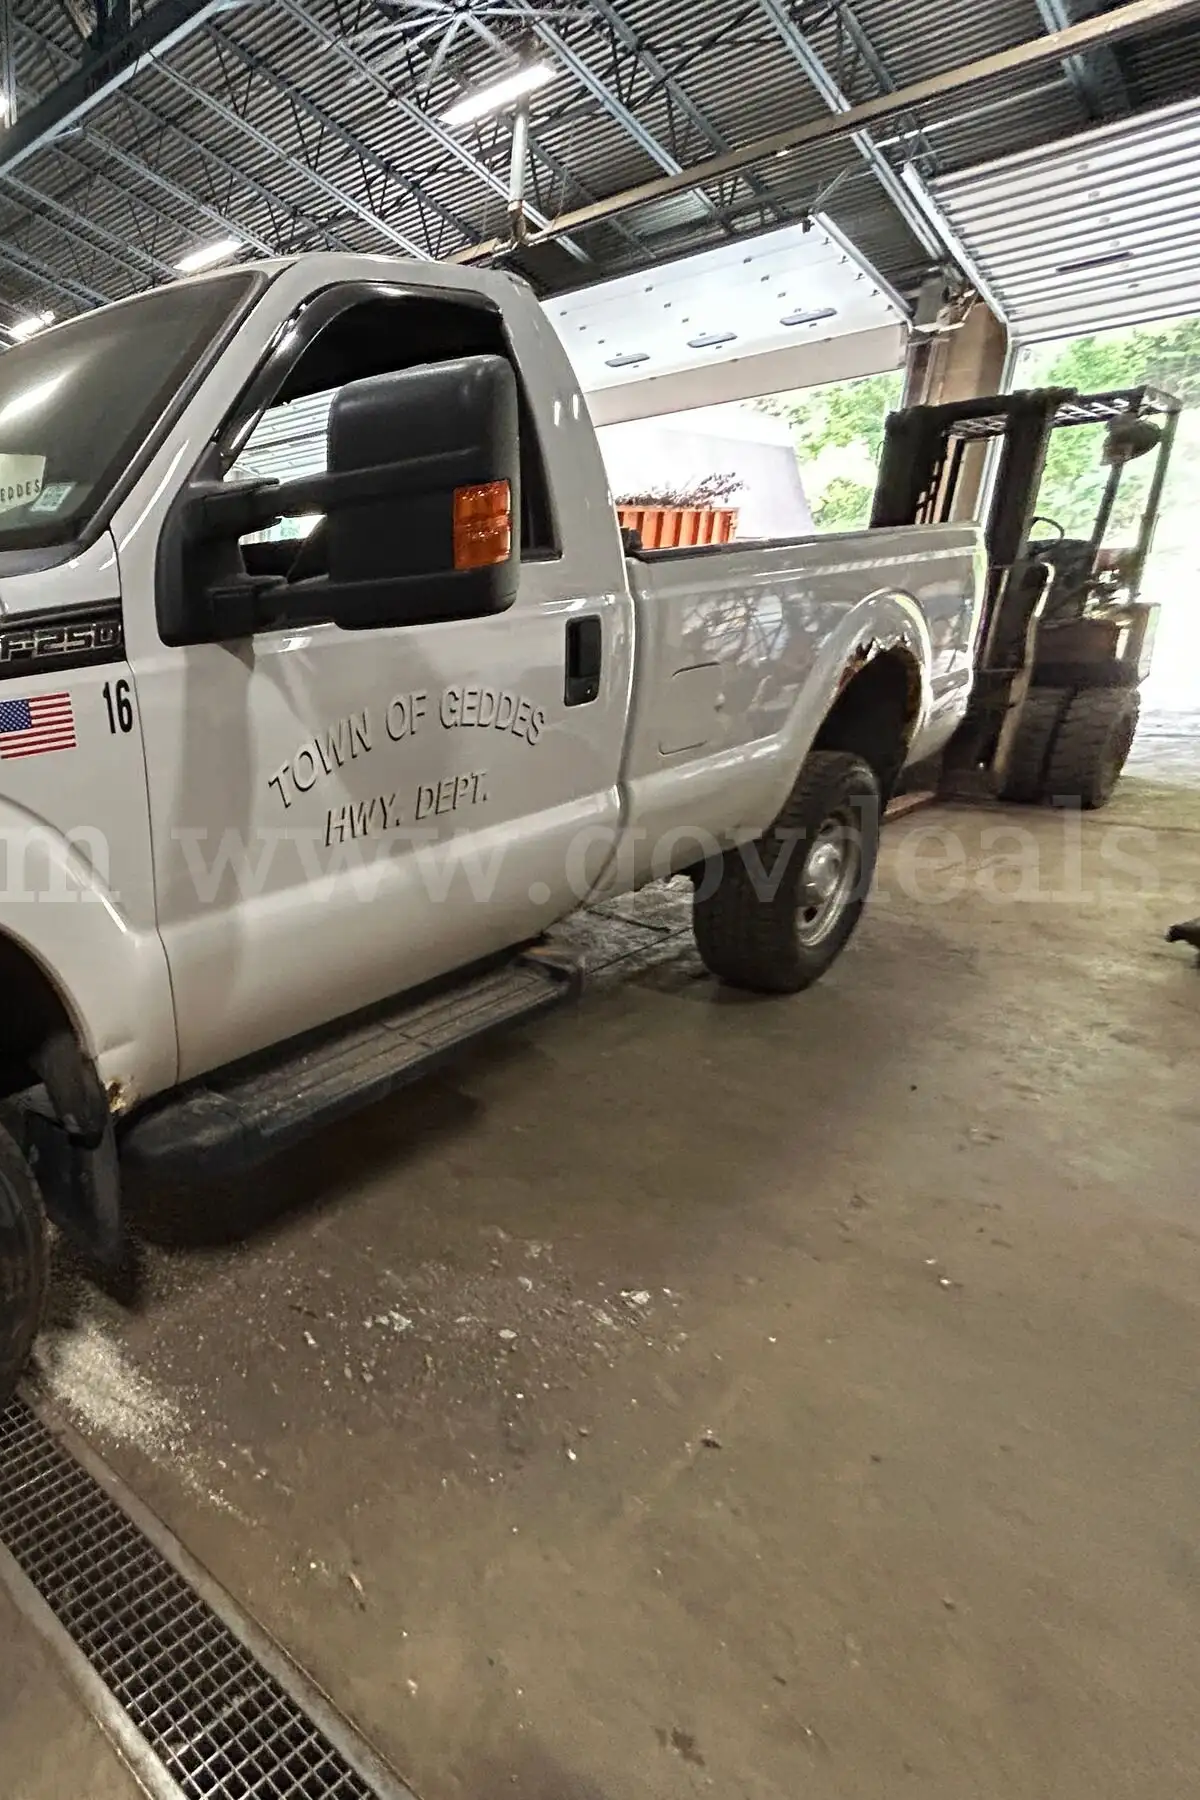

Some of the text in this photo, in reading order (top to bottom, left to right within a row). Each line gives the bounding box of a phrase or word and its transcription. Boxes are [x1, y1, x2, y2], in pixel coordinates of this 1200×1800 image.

[102, 678, 133, 734] 16
[267, 686, 546, 809] TOWN OF GEDDES
[324, 771, 490, 848] HWY. DEPT.
